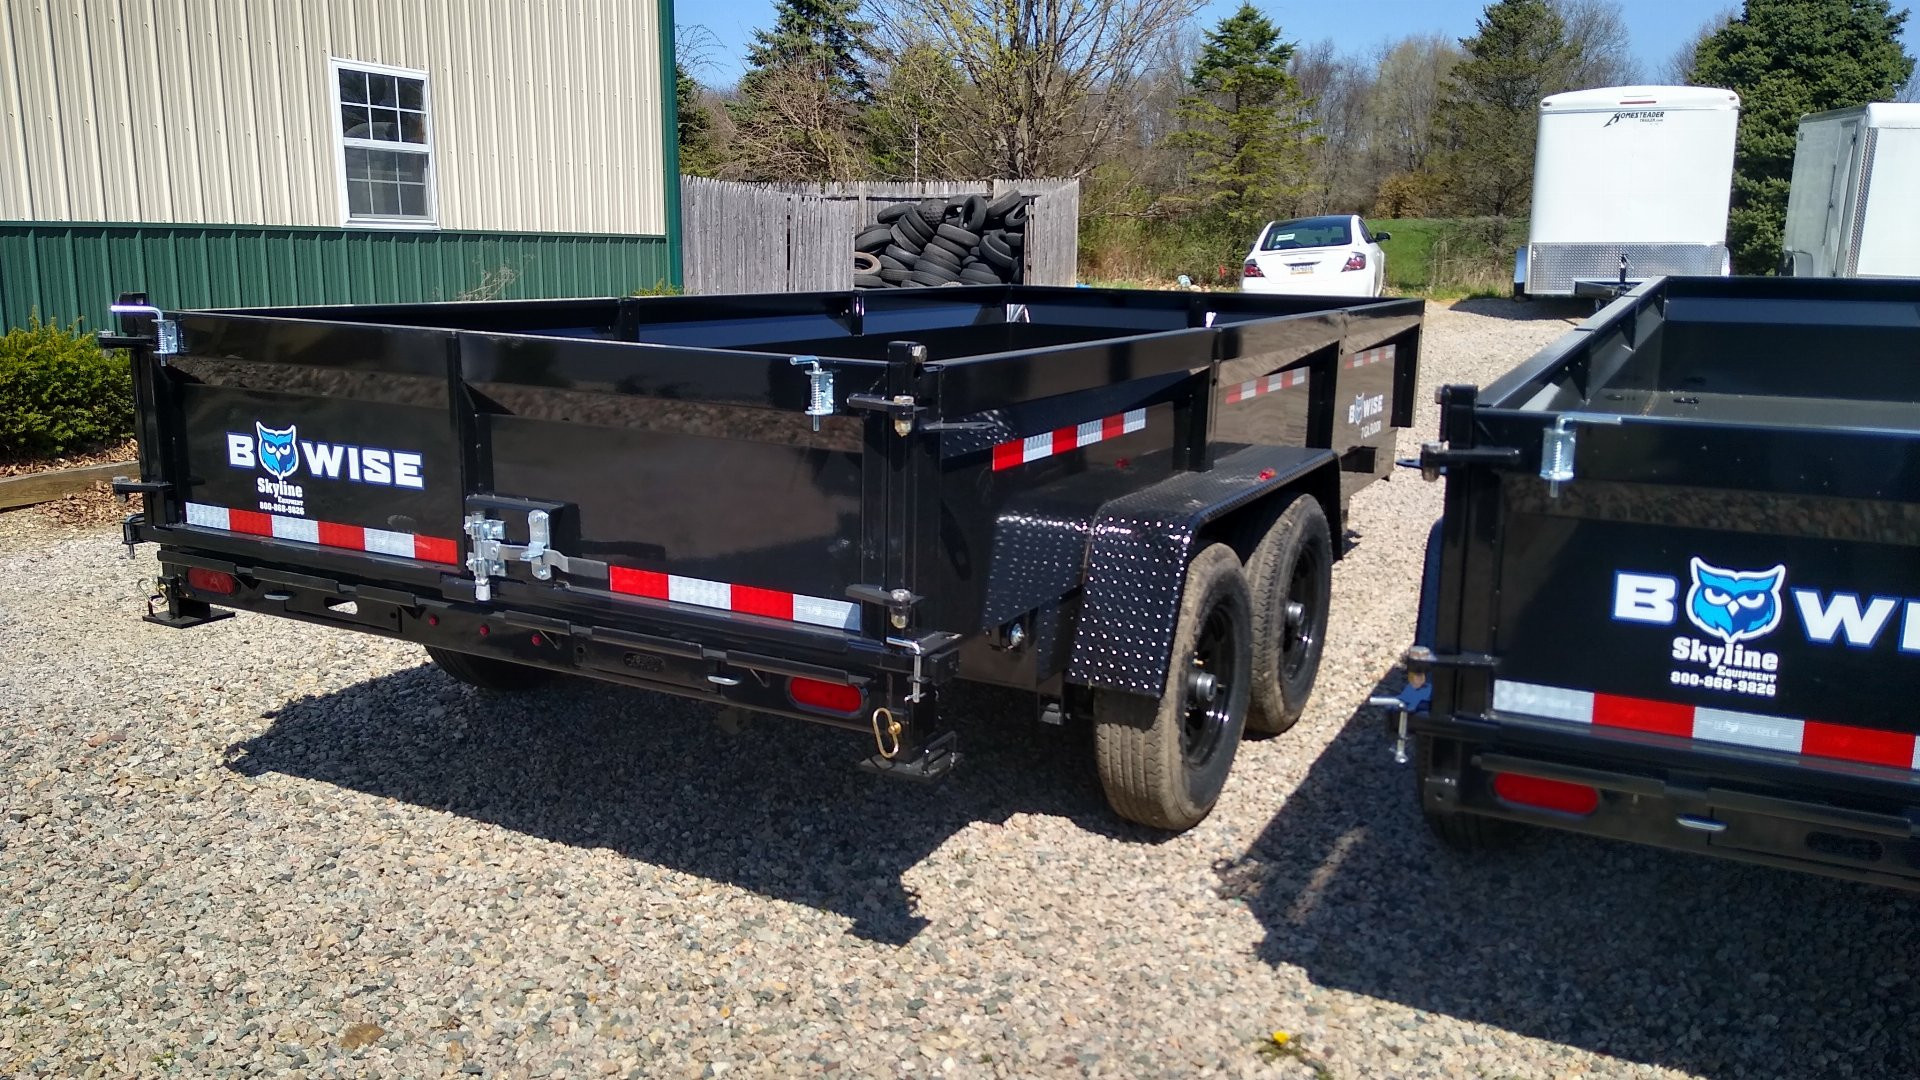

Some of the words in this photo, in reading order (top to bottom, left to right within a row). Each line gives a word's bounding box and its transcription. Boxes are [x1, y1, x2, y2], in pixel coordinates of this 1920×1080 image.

[1603, 111, 1665, 127] HOMESTEADER
[257, 477, 303, 498] Skyline
[1671, 636, 1779, 671] Skyline
[1670, 671, 1777, 697] 800-868-9826
[1716, 665, 1777, 683] EQUIPMENT
